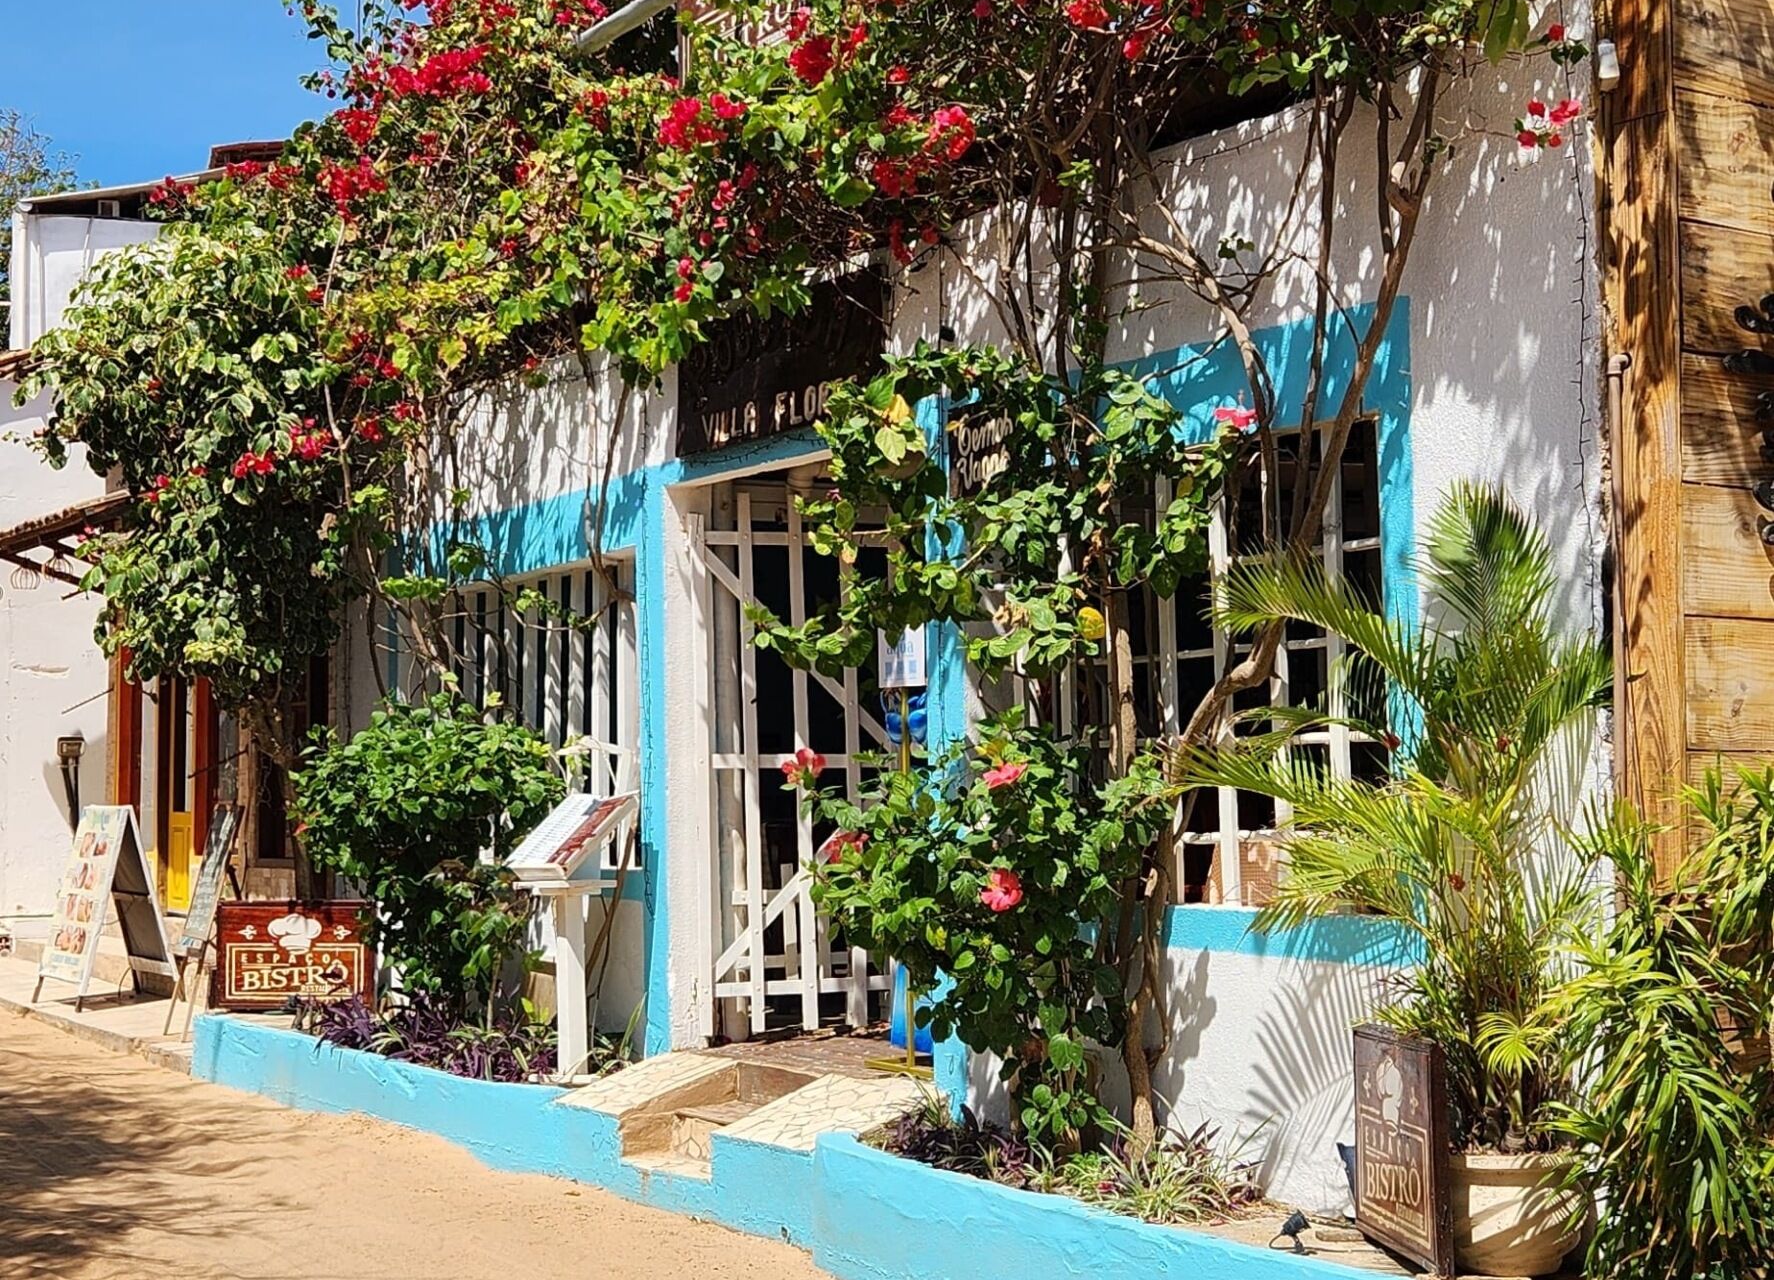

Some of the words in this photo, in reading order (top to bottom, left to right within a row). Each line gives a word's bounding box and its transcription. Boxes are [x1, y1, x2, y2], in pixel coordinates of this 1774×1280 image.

[702, 401, 759, 444] VILLA
[241, 953, 331, 966] ESPAÇO
[242, 959, 349, 991] BISTRÔ
[1365, 1158, 1422, 1207] BISTRÔ
